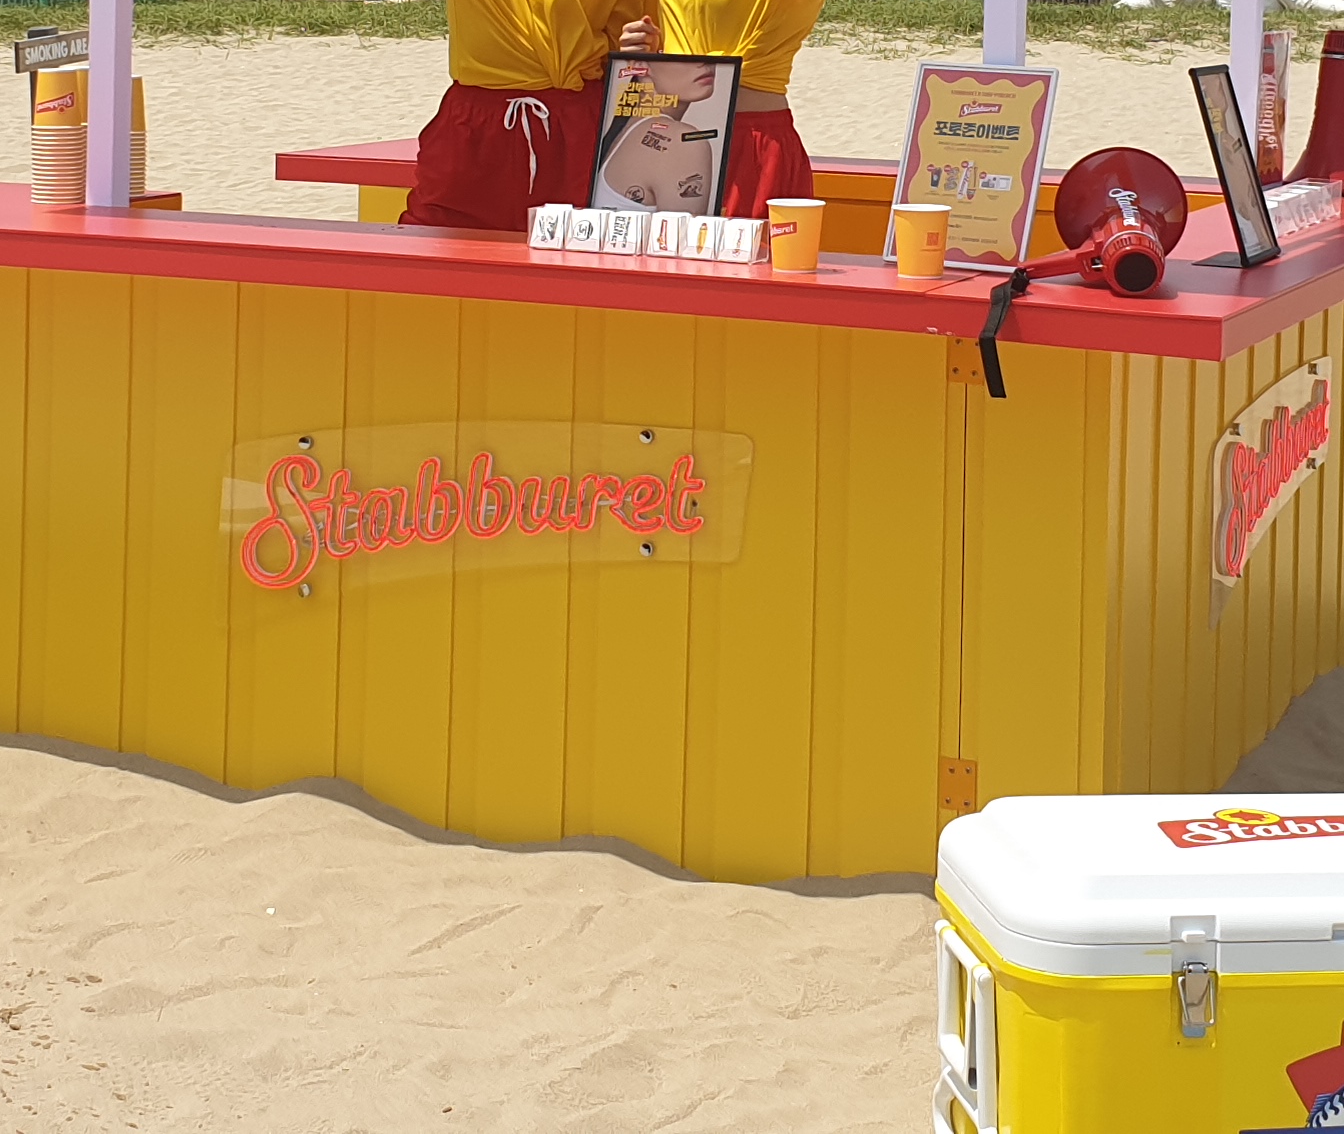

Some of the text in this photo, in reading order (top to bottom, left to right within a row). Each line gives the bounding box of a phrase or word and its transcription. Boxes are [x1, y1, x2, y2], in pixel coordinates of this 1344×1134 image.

[24, 37, 88, 65] SMOKING ARE
[240, 452, 707, 589] Stabburet
[1218, 379, 1331, 578] Stabburet
